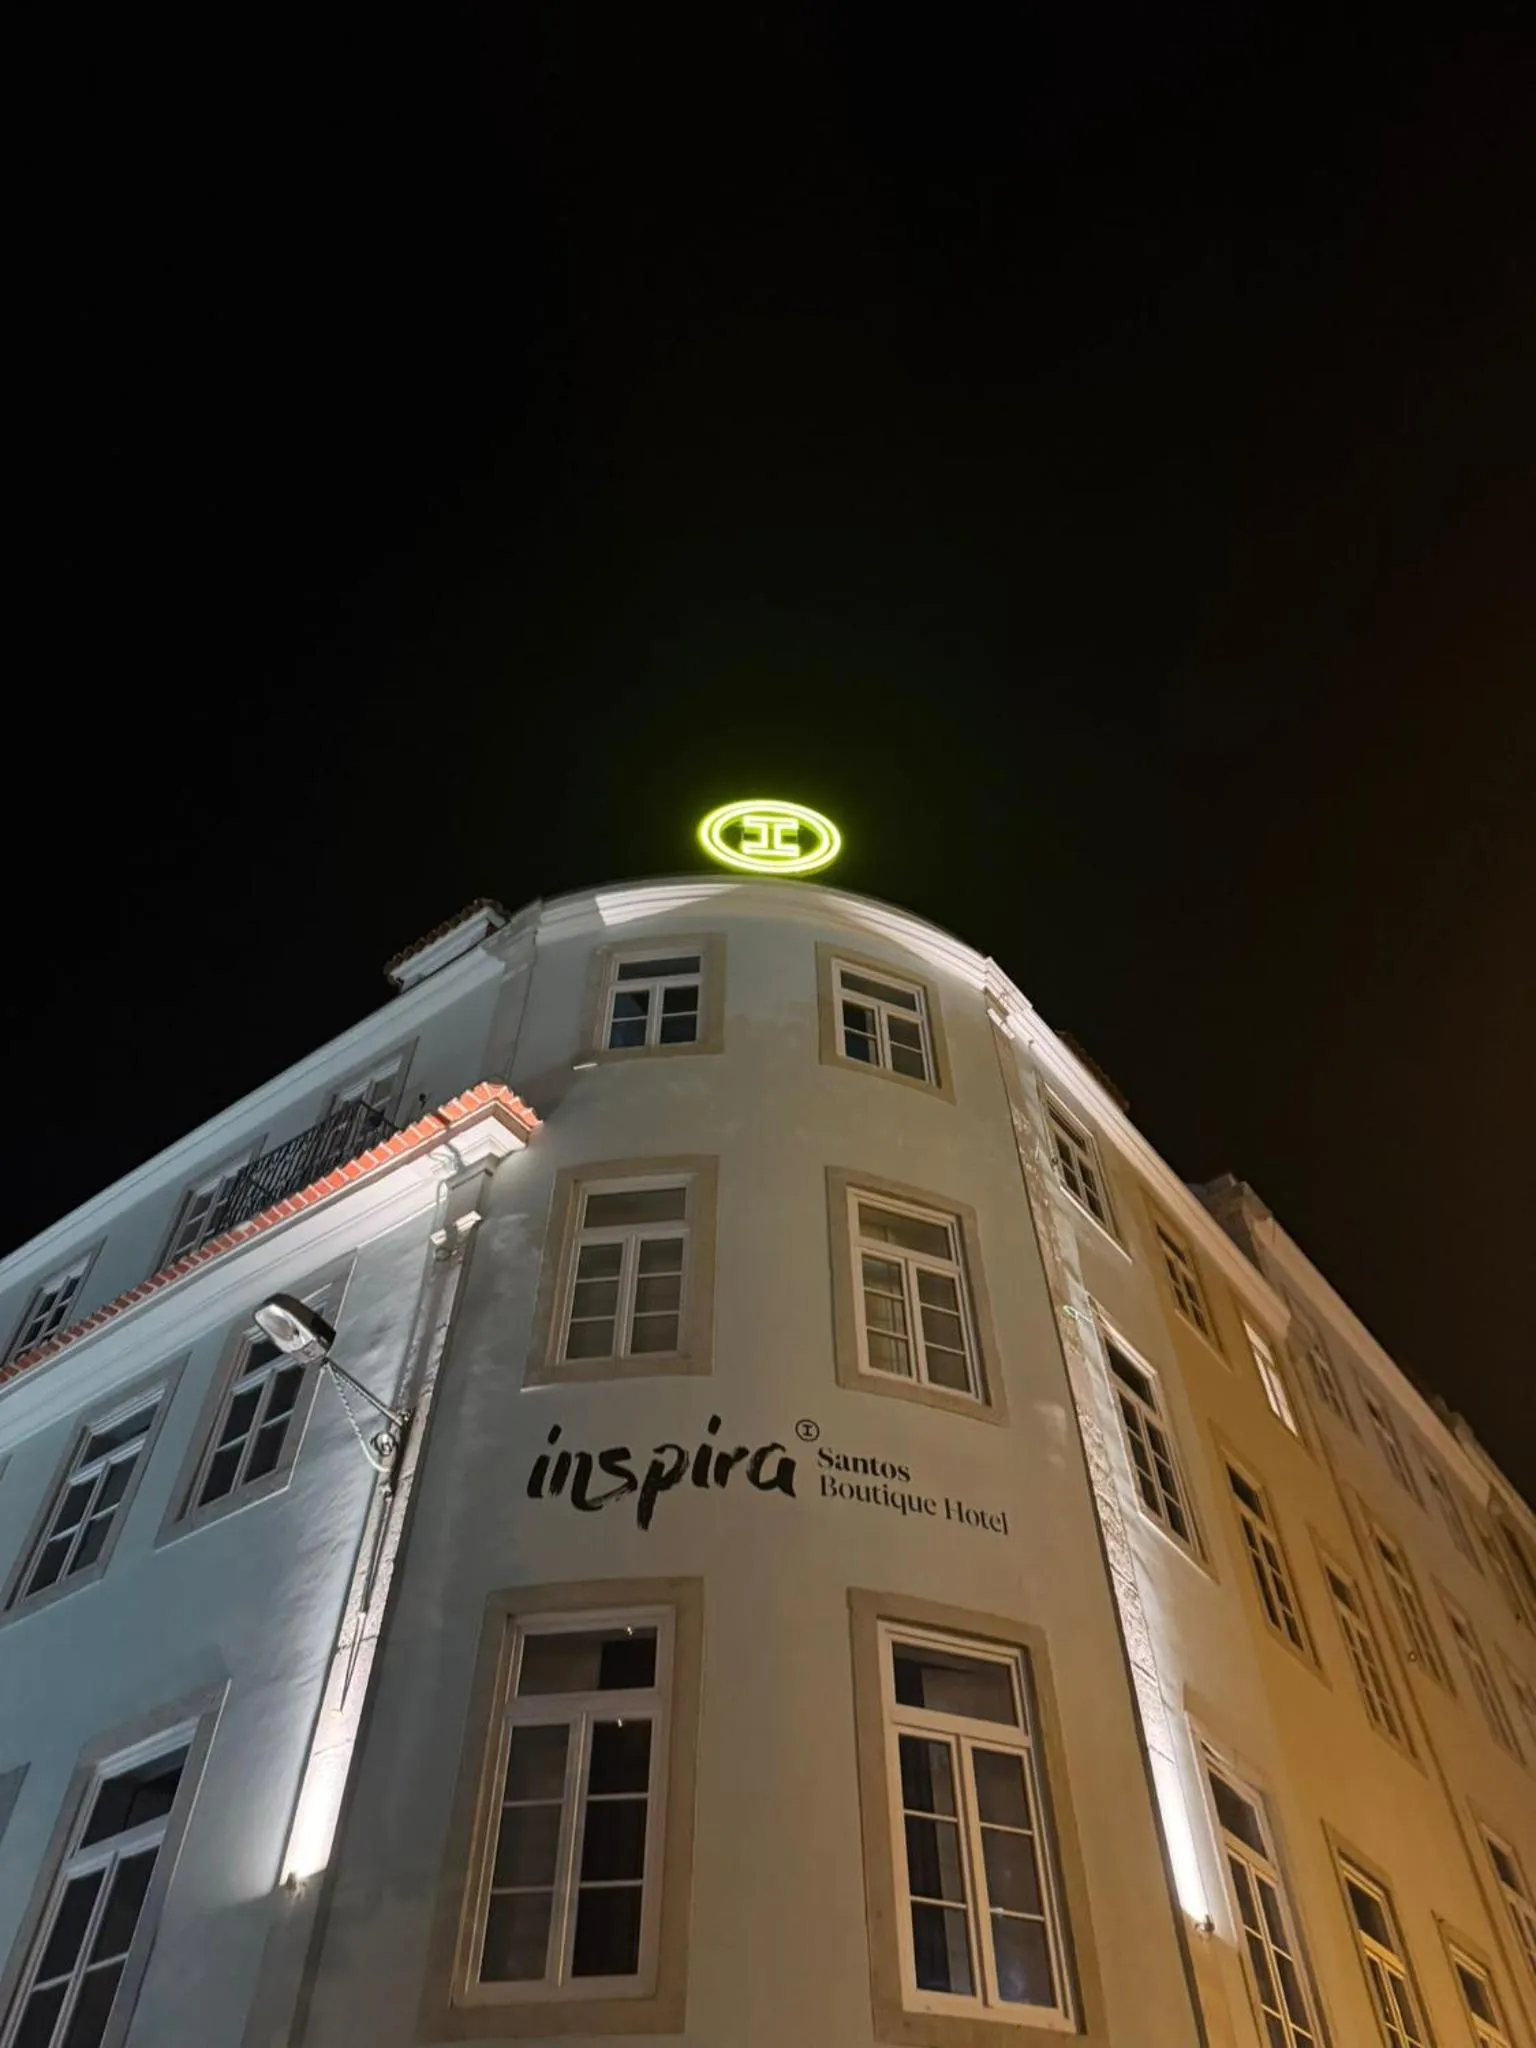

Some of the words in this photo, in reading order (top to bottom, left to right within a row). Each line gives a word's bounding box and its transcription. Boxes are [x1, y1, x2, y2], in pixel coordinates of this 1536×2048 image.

[527, 1415, 796, 1530] inspira
[817, 1447, 911, 1482] Santos
[820, 1475, 936, 1516] Boutique
[944, 1497, 1009, 1535] Hotel
